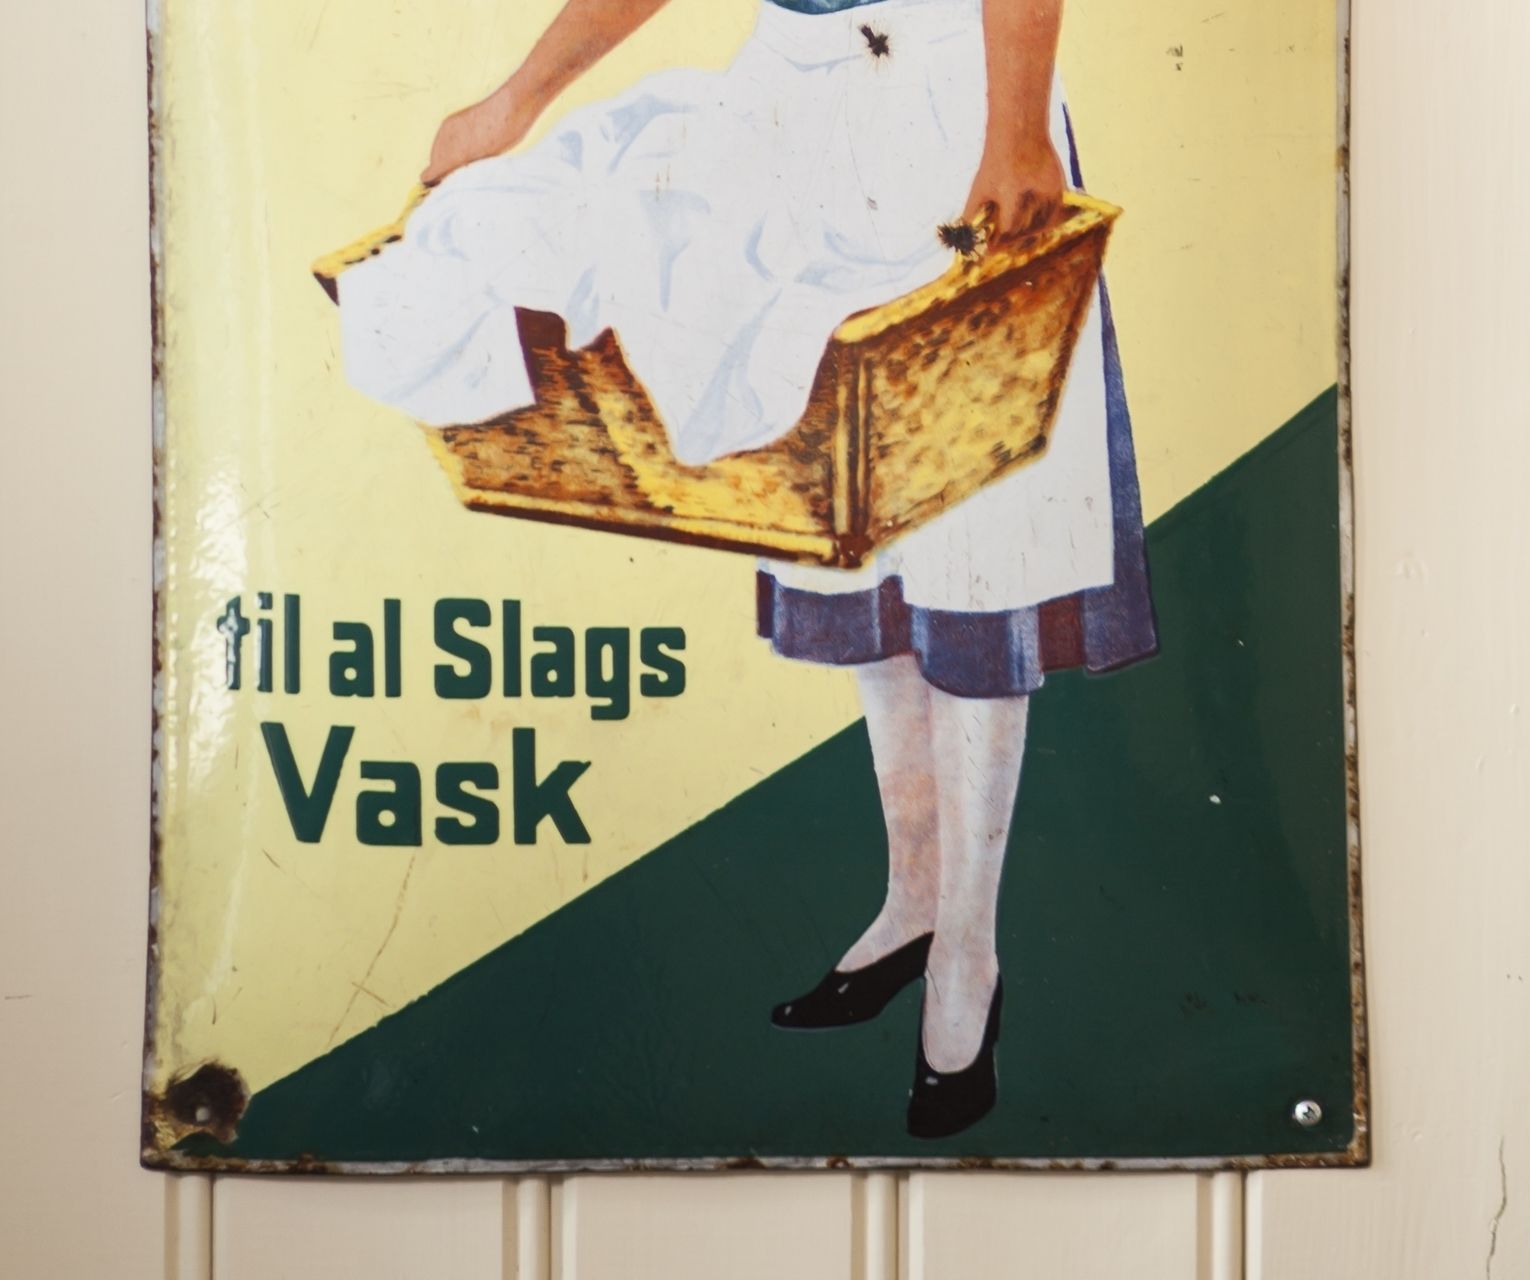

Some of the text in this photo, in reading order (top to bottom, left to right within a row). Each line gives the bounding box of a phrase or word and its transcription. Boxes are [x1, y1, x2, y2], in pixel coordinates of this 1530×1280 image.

[216, 591, 687, 721] til al Slags
[260, 720, 593, 847] Vask
